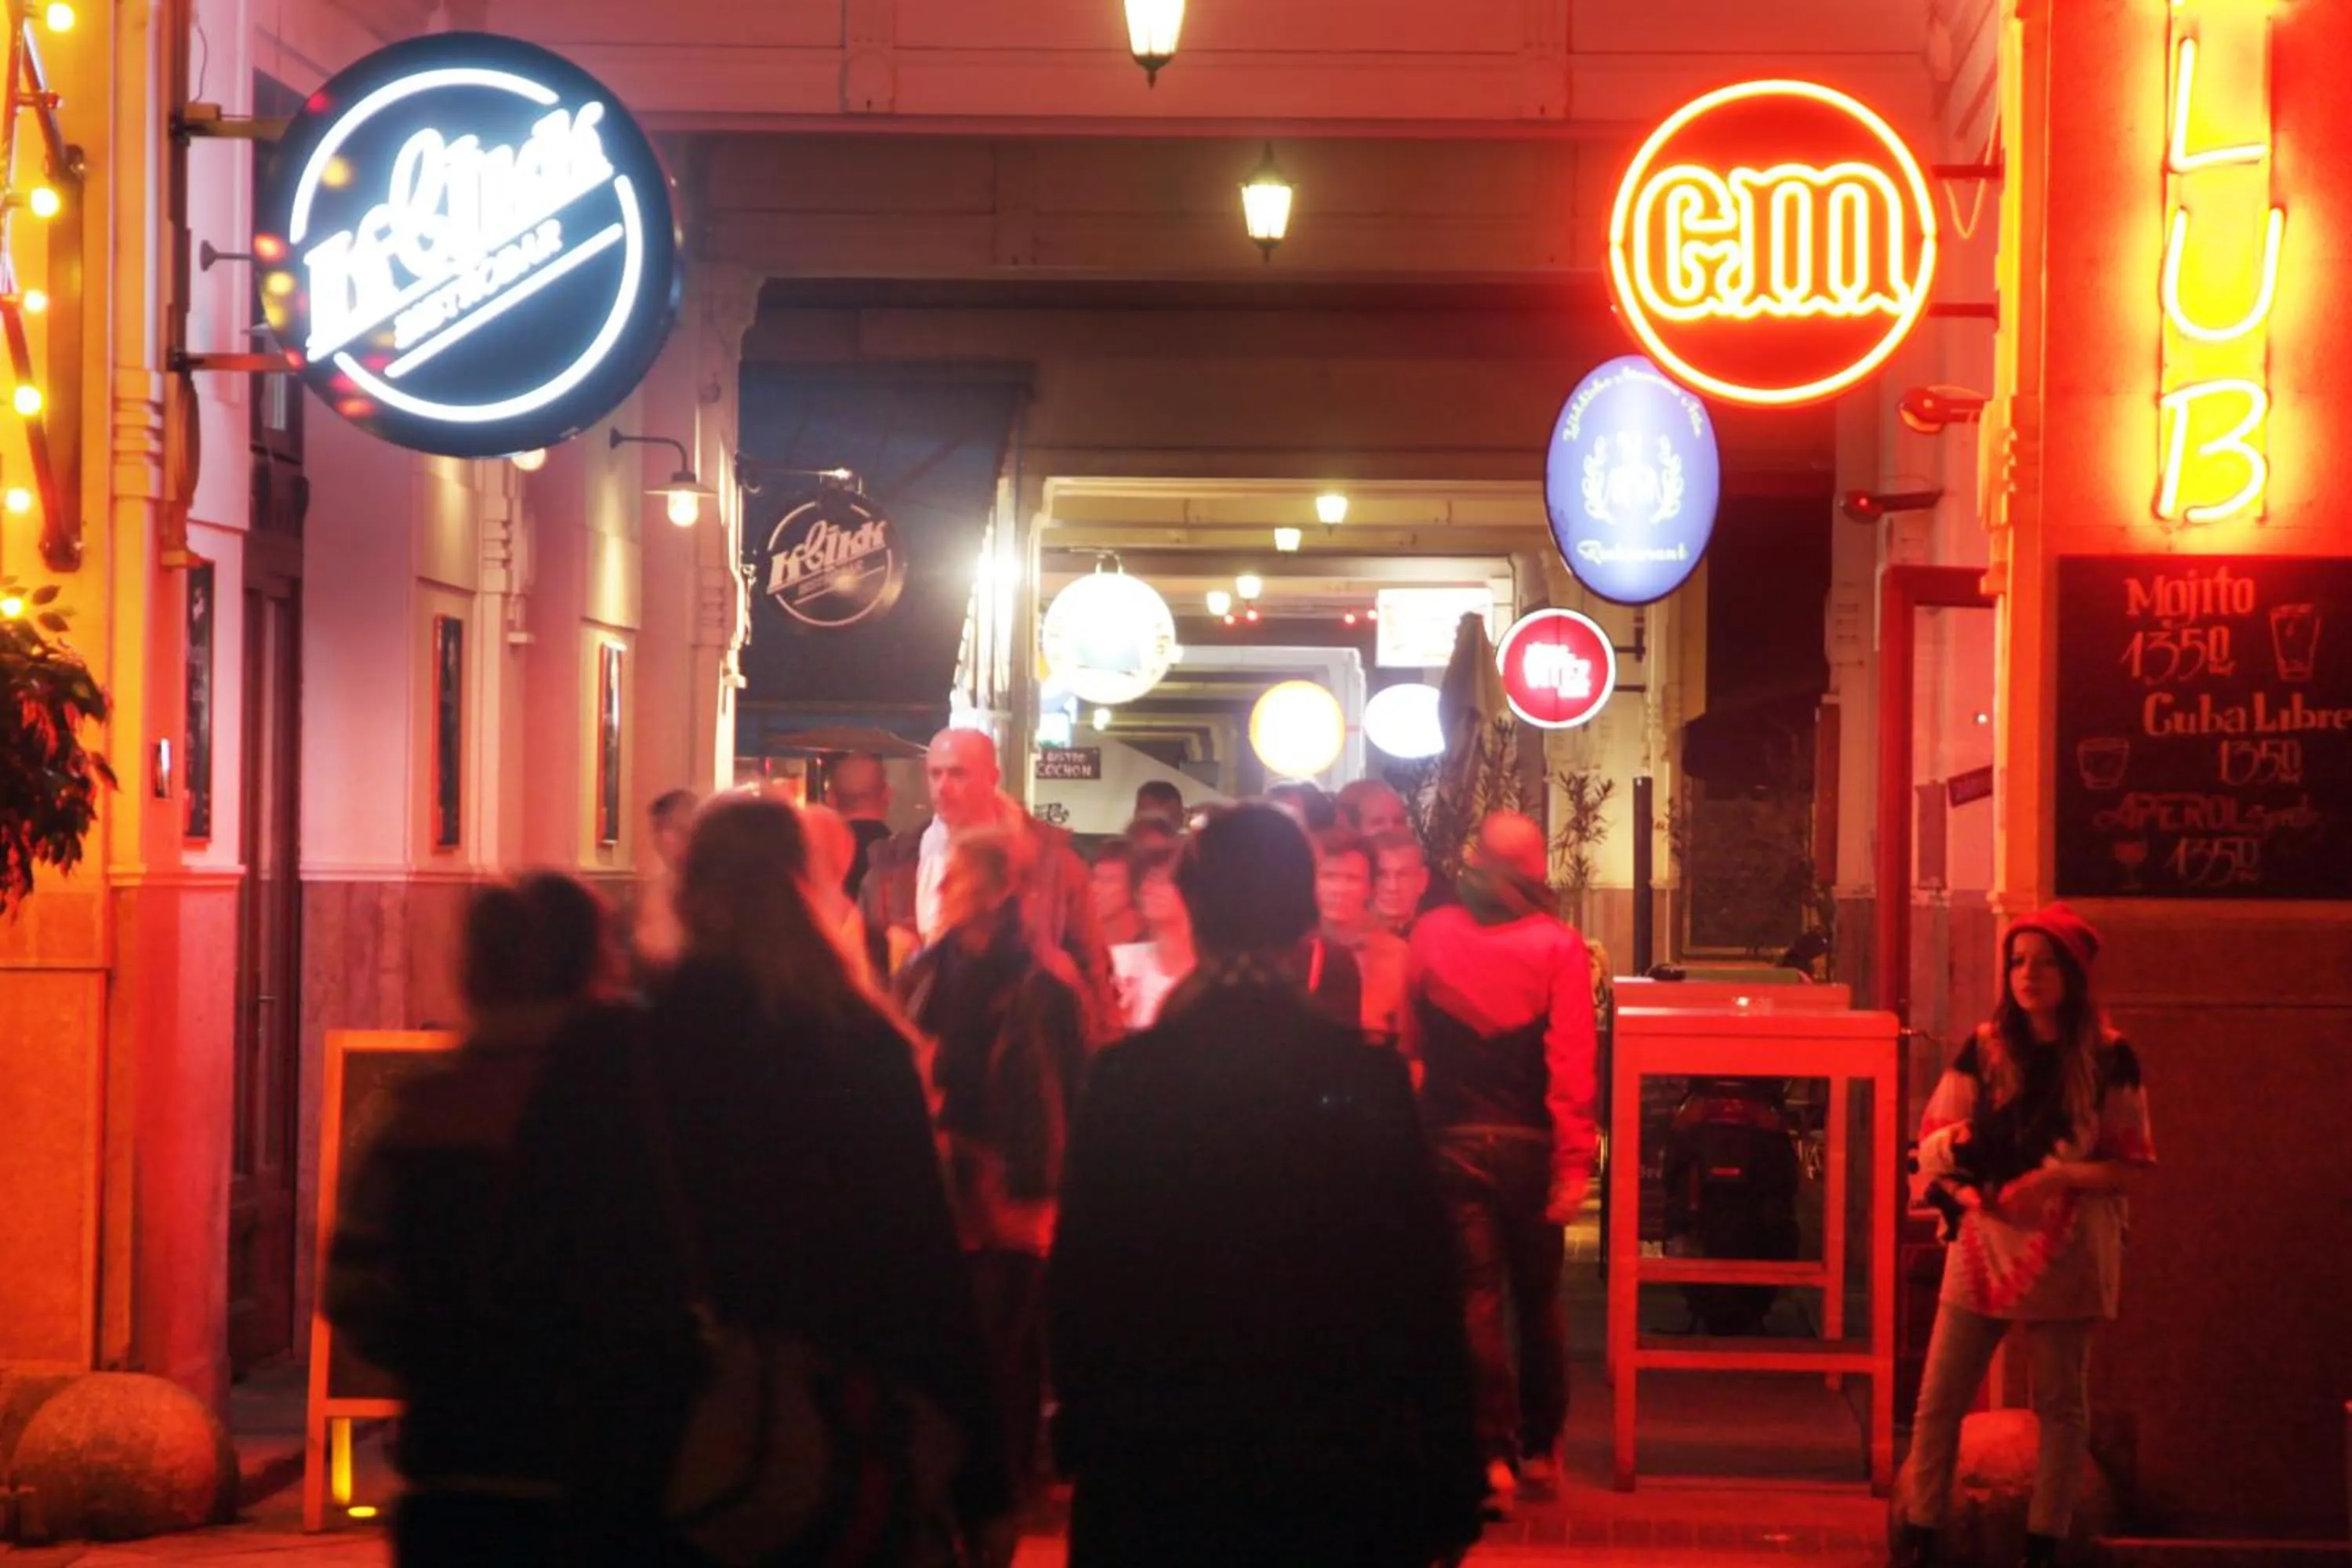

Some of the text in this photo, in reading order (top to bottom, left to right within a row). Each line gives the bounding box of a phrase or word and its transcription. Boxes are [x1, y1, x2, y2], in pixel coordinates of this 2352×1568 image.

[2156, 0, 2287, 524] LUB
[2123, 564, 2256, 629] Mojito
[2143, 690, 2352, 737] Cuba Libre
